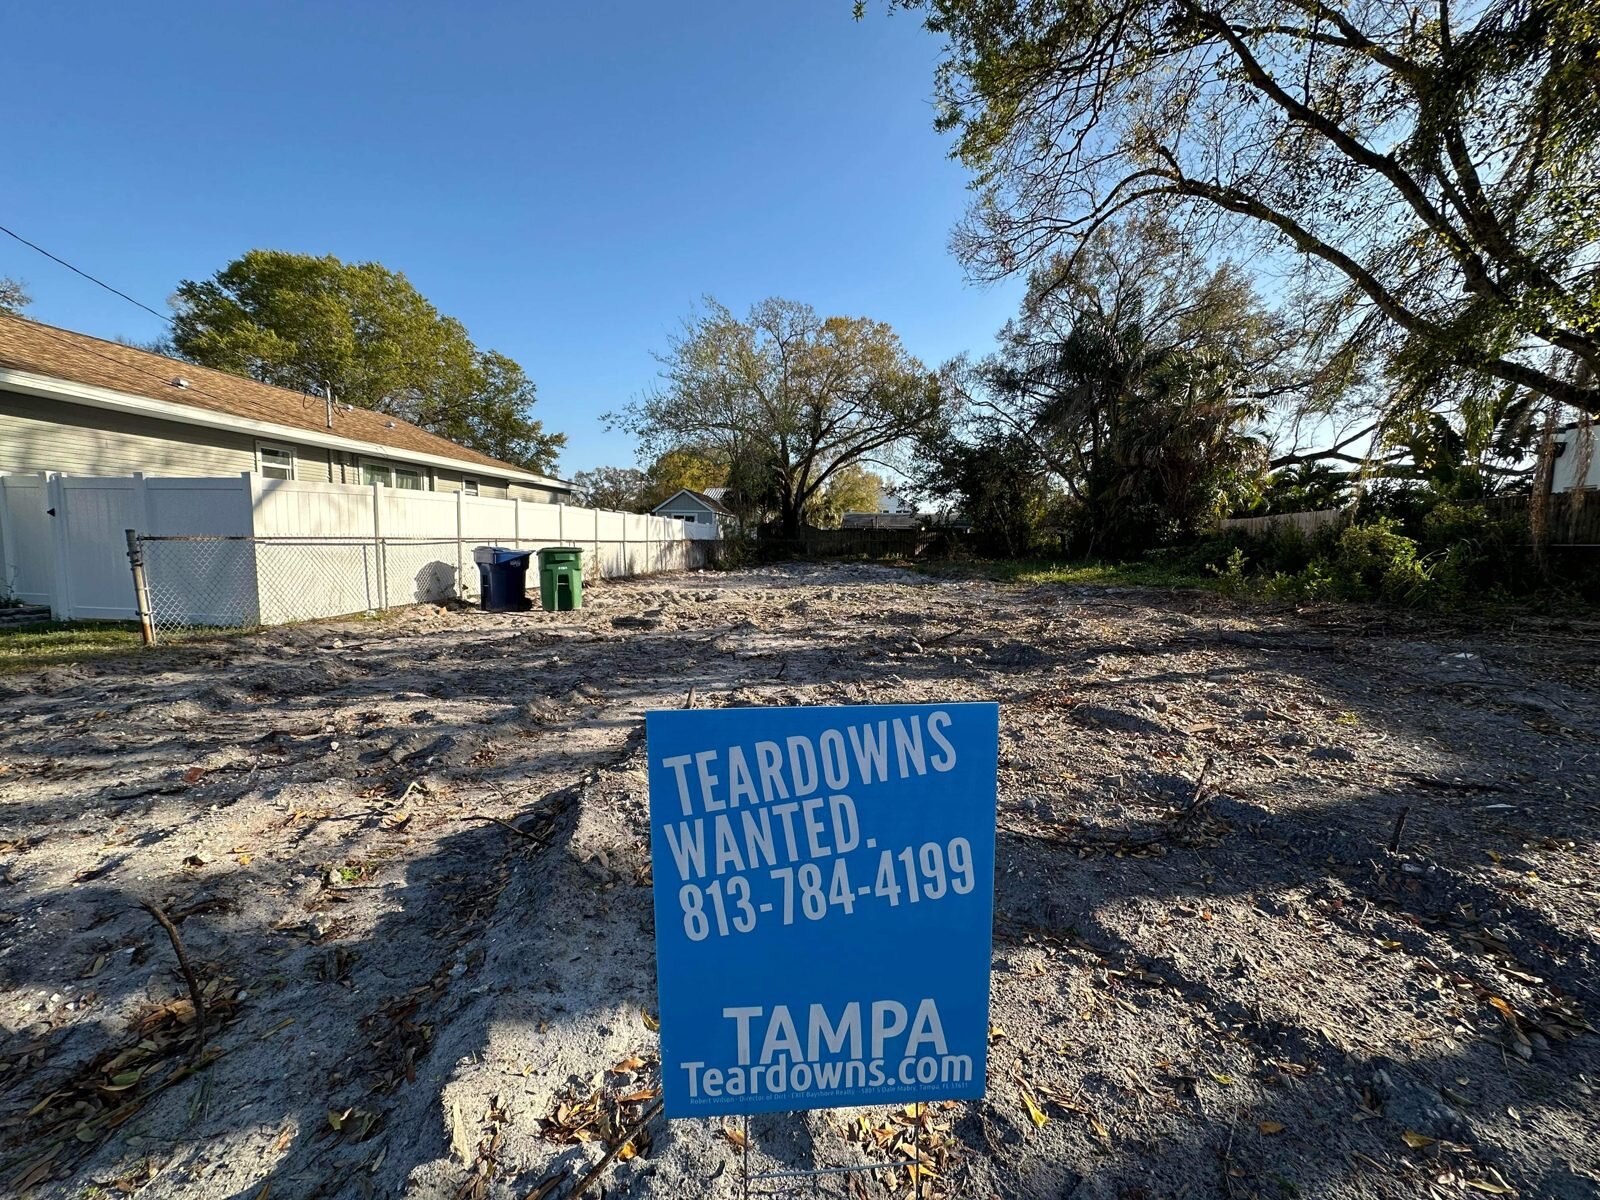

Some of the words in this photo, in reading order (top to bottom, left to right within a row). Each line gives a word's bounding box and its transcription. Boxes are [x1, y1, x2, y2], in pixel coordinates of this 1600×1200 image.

[662, 711, 957, 816] TEARDOWNS
[663, 794, 878, 880] WANTED.
[678, 837, 975, 942] 813-784-4199
[722, 998, 948, 1066] TAMPA
[680, 1053, 973, 1097] Teardowns.com
[690, 1097, 712, 1105] Robert
[713, 1096, 735, 1104] Wilson
